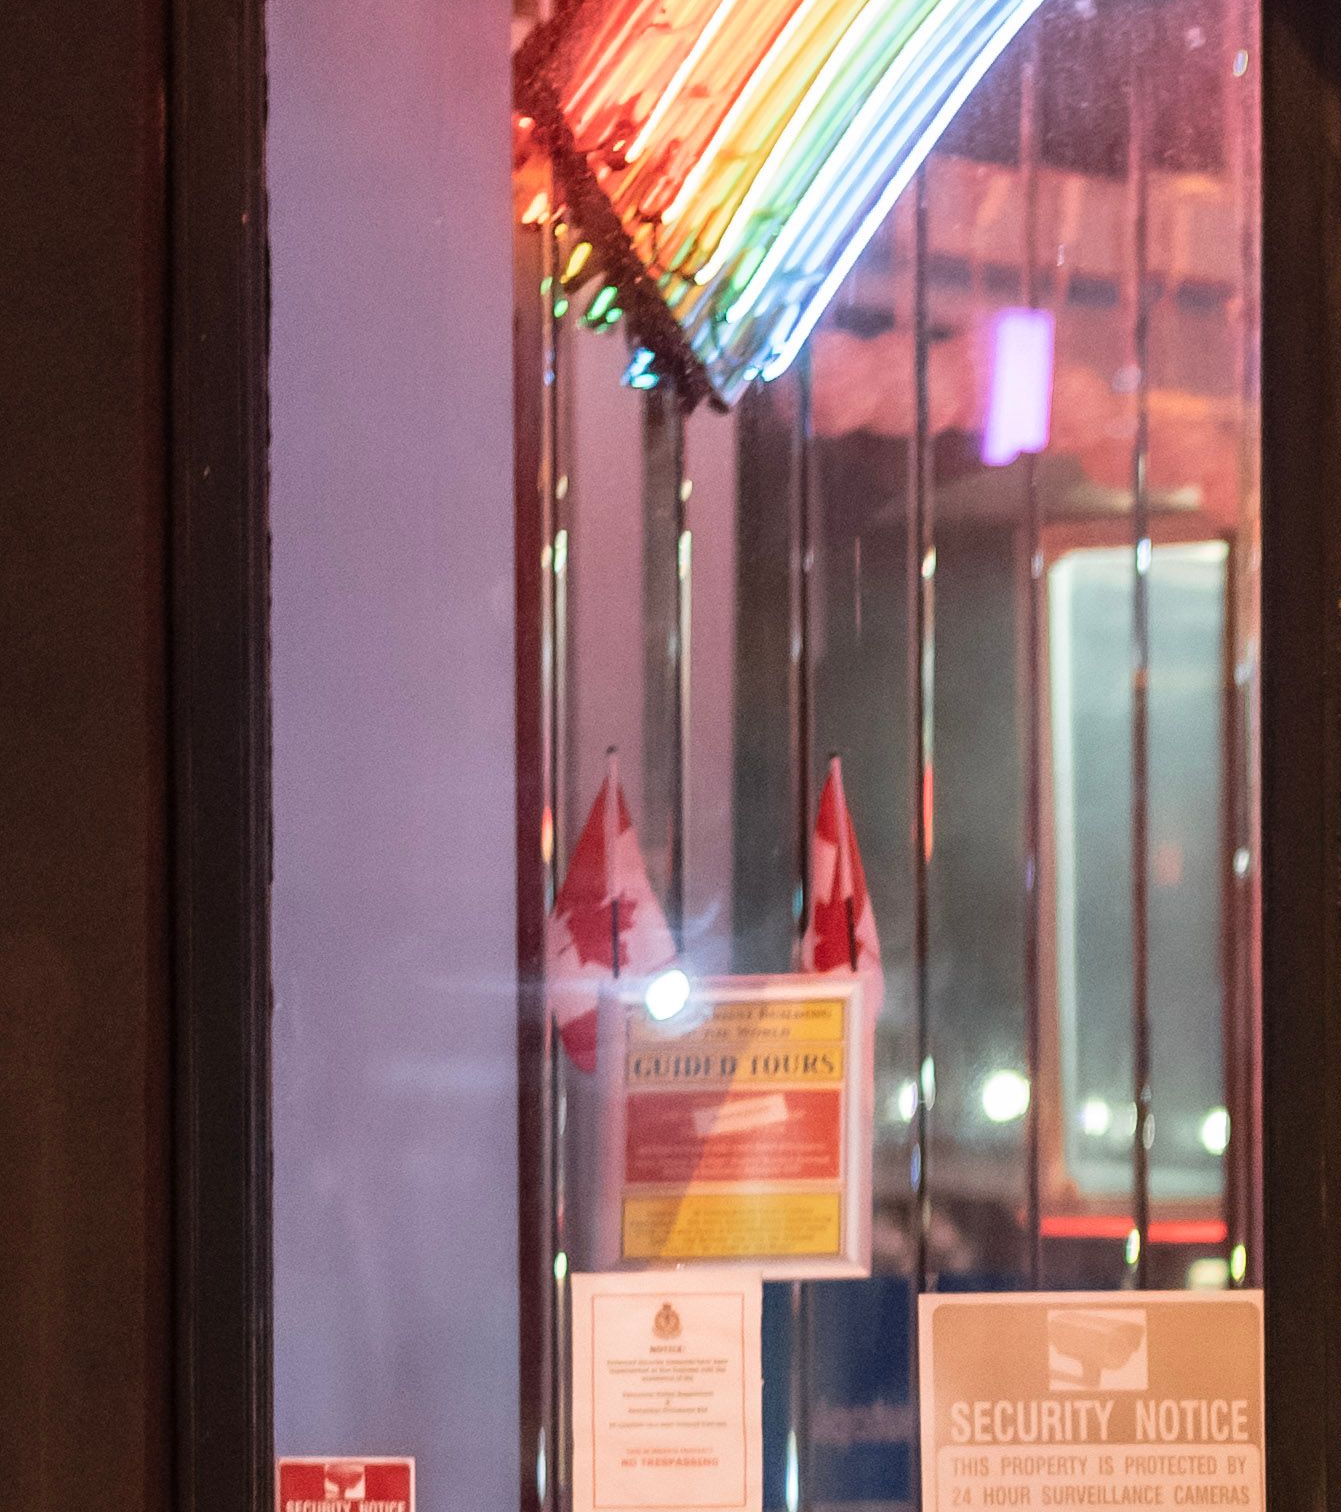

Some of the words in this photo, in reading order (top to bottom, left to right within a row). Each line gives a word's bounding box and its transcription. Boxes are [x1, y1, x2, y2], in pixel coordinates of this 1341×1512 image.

[633, 1055, 737, 1077] GUIDED
[746, 1053, 834, 1075] TOURS
[950, 1399, 1115, 1443] SECURITY
[1135, 1398, 1250, 1442] NOTICE
[954, 1456, 989, 1476] THIS
[1000, 1455, 1087, 1475] PROPERTY
[1099, 1455, 1114, 1475] IS
[1125, 1455, 1217, 1475] PROTECTED
[1227, 1455, 1247, 1474] BY
[952, 1486, 972, 1506] 24
[983, 1486, 1031, 1505] HOUR
[1041, 1485, 1165, 1505] SURVEILLANCE
[1174, 1485, 1249, 1505] CAMERAS
